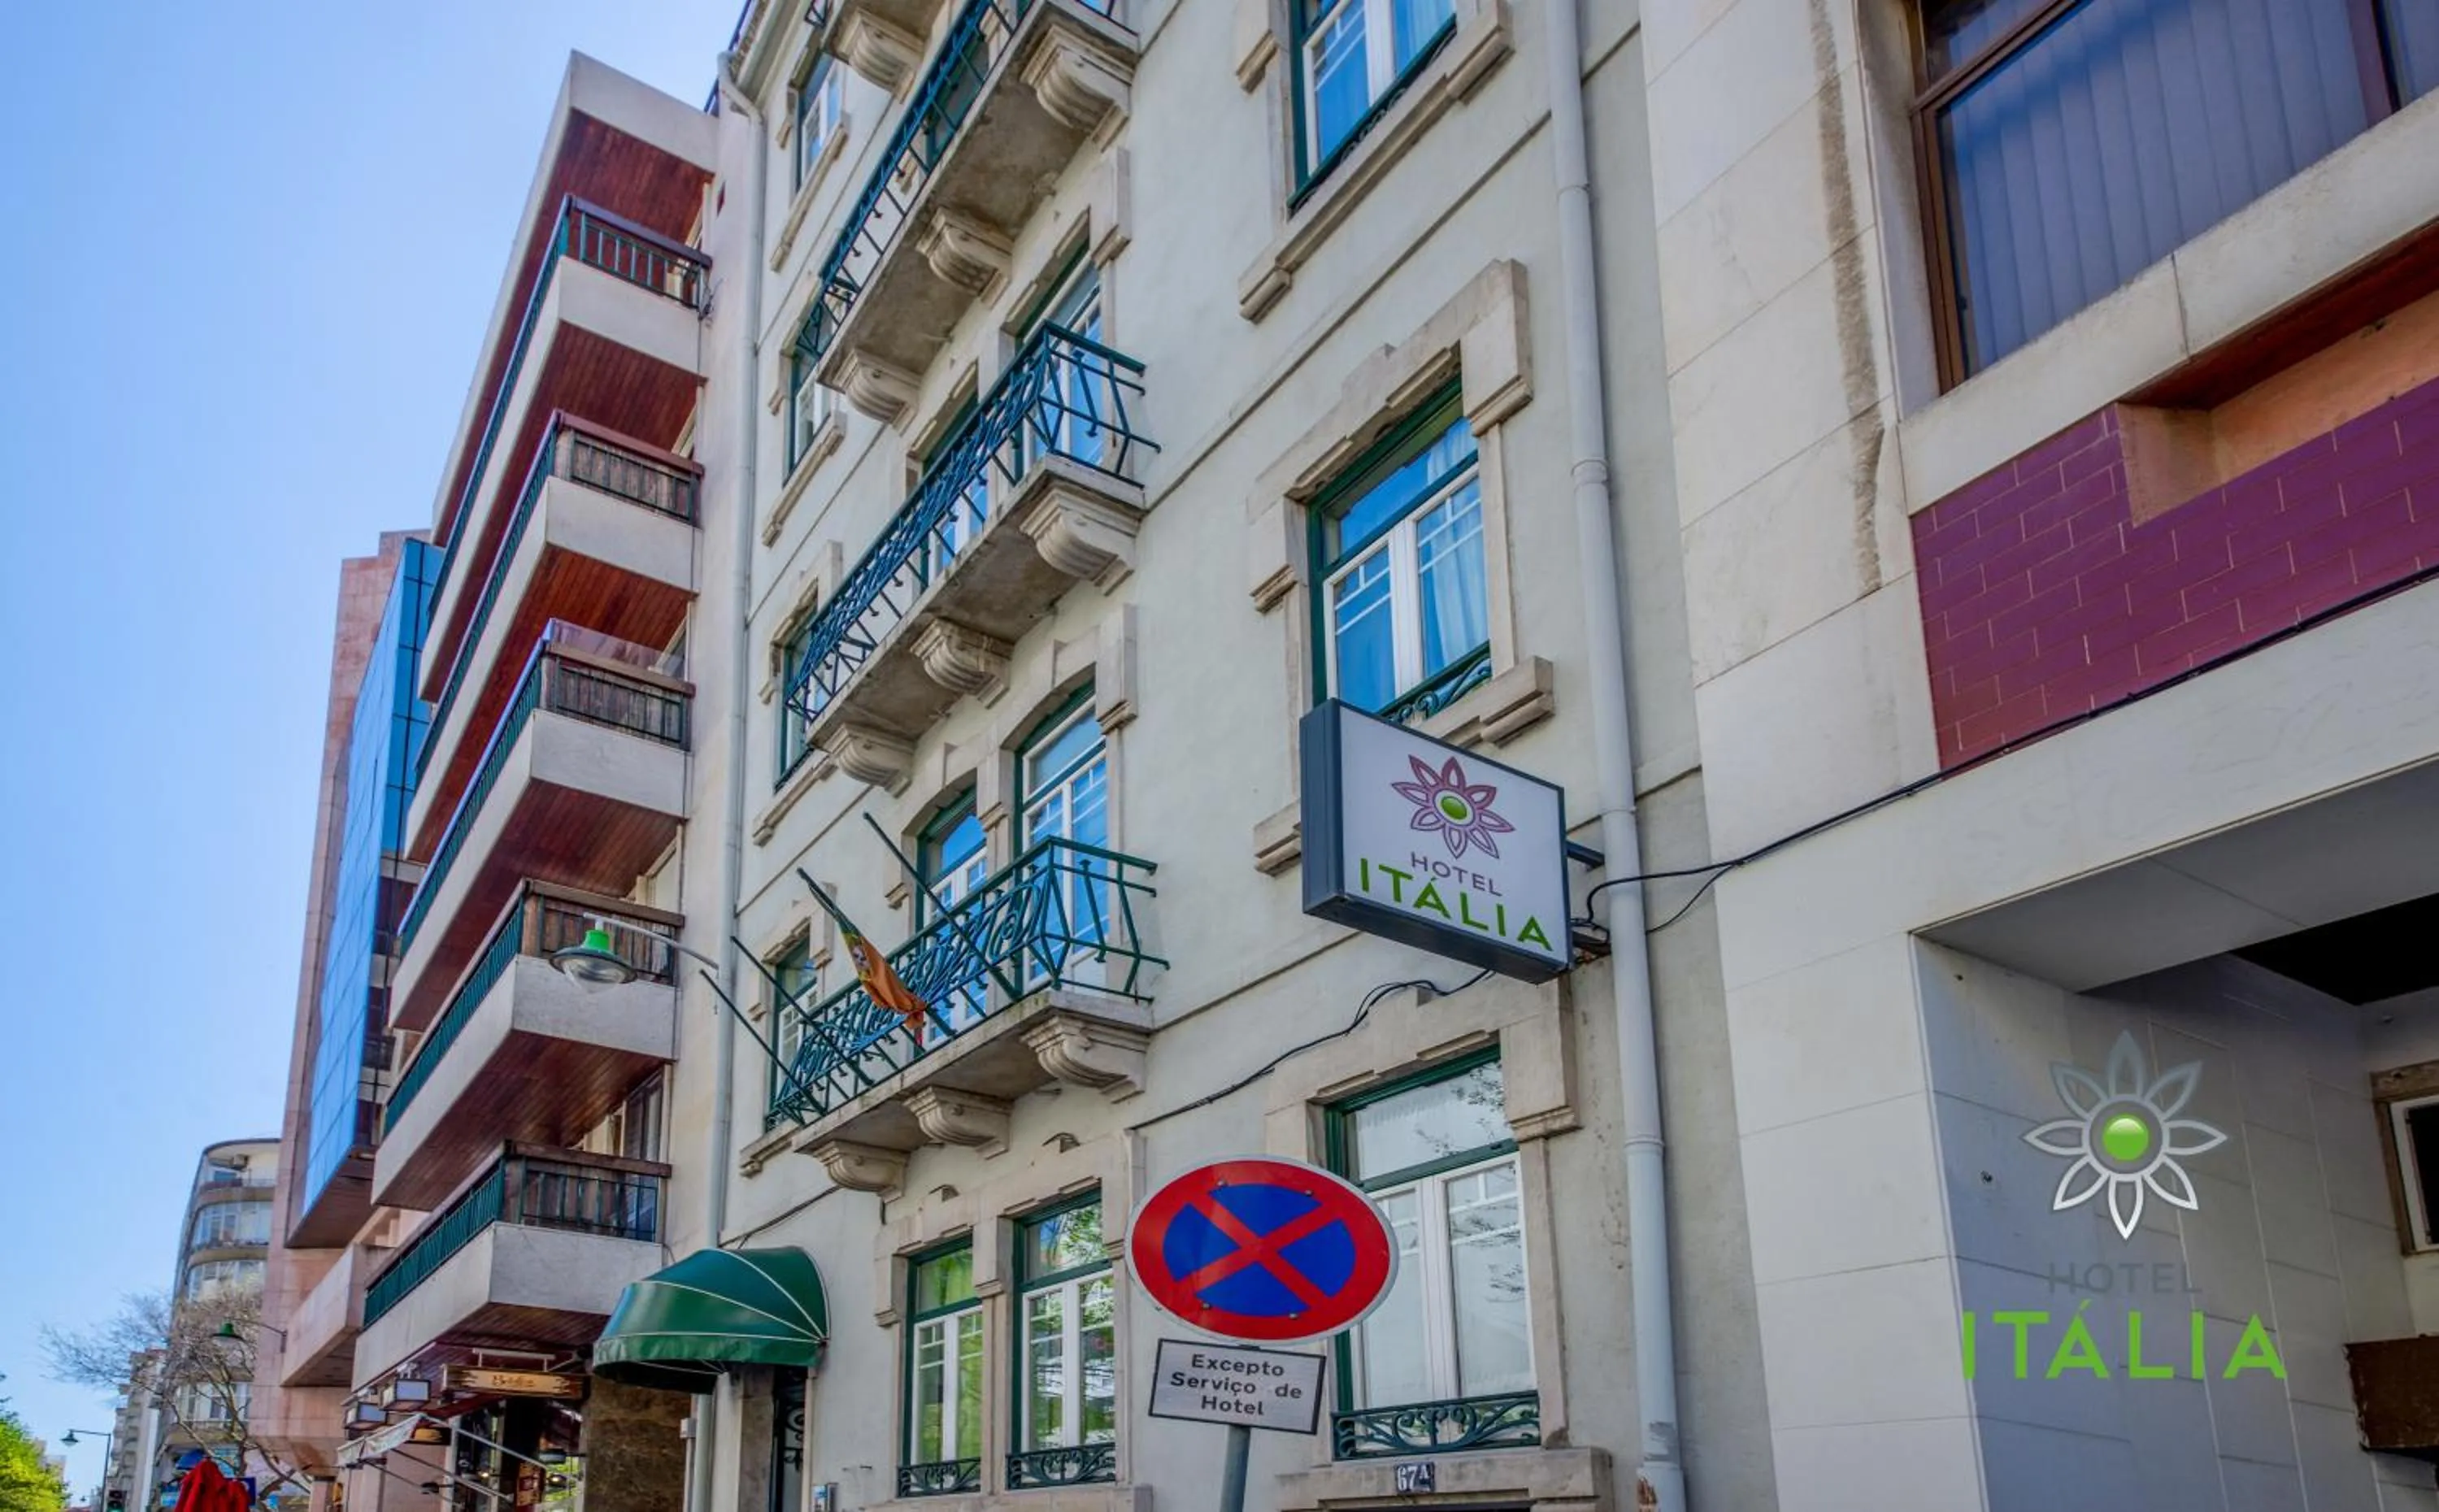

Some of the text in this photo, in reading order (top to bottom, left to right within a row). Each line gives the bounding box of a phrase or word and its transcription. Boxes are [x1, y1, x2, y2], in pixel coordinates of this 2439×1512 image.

[1411, 851, 1502, 897] HOTEL
[1360, 858, 1553, 951] ITÁLIA
[1192, 1353, 1285, 1376] Excepto
[1170, 1371, 1303, 1399] Serviço de
[1201, 1395, 1265, 1415] Hotel
